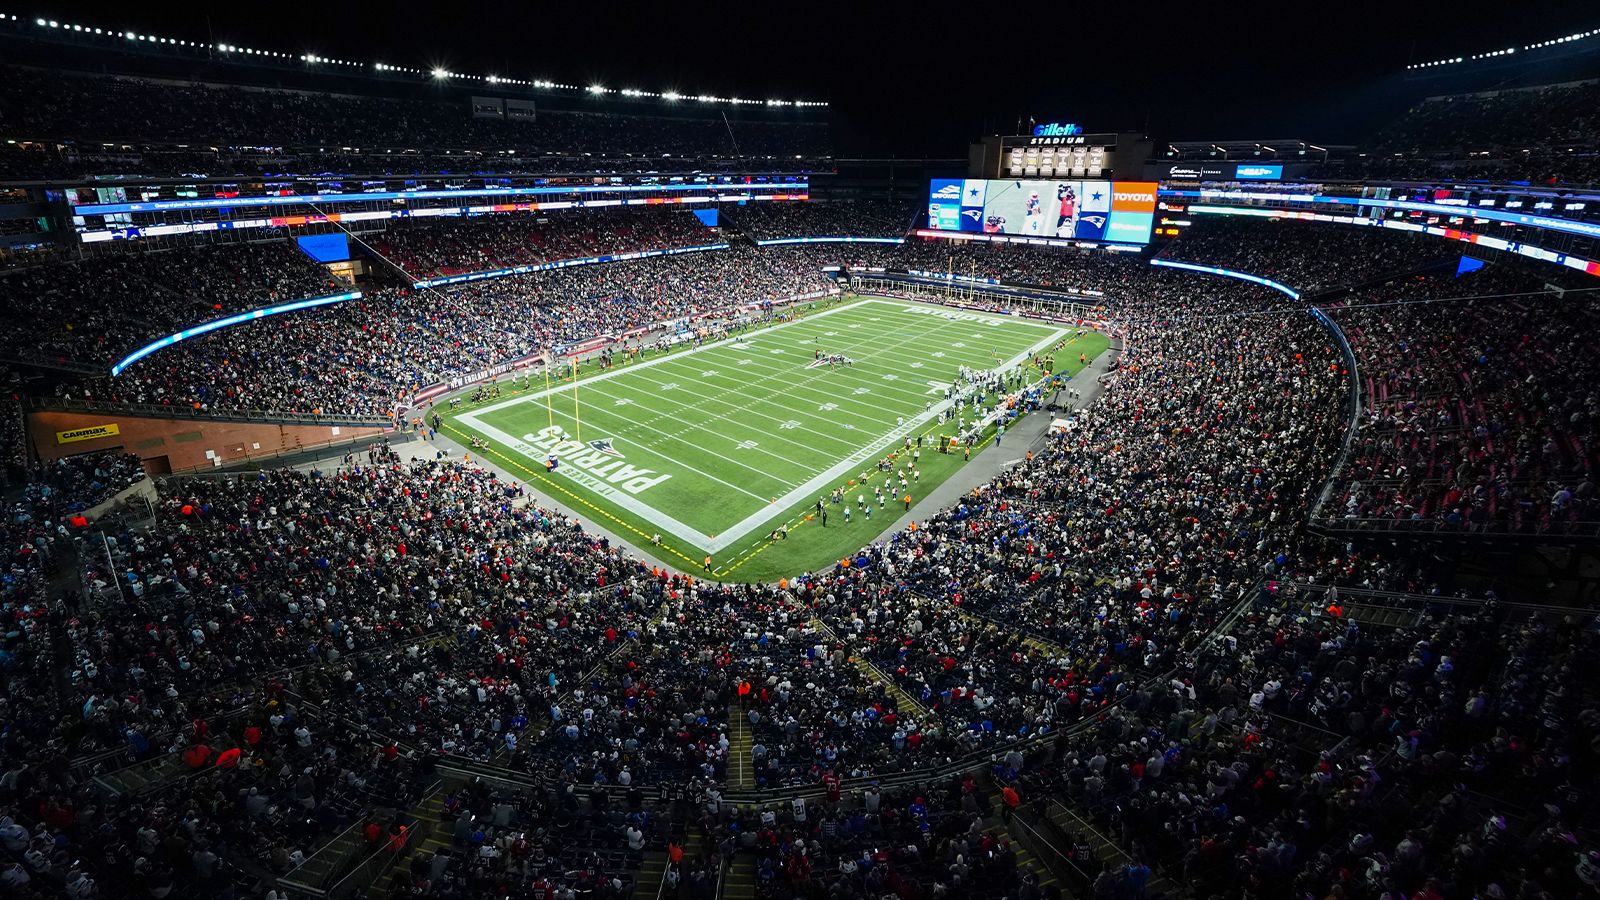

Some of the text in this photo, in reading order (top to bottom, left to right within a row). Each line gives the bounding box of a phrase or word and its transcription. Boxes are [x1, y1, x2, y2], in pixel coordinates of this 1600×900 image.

[1034, 123, 1083, 136] Gillette
[1030, 137, 1085, 145] STADIUM
[1169, 166, 1200, 174] Encore
[1113, 192, 1154, 202] TOYOTA
[450, 378, 463, 389] NEW
[464, 371, 488, 385] ENGLAND
[523, 425, 673, 494] PATRIOTS
[562, 468, 600, 489] TAKES
[598, 487, 616, 496] IT
